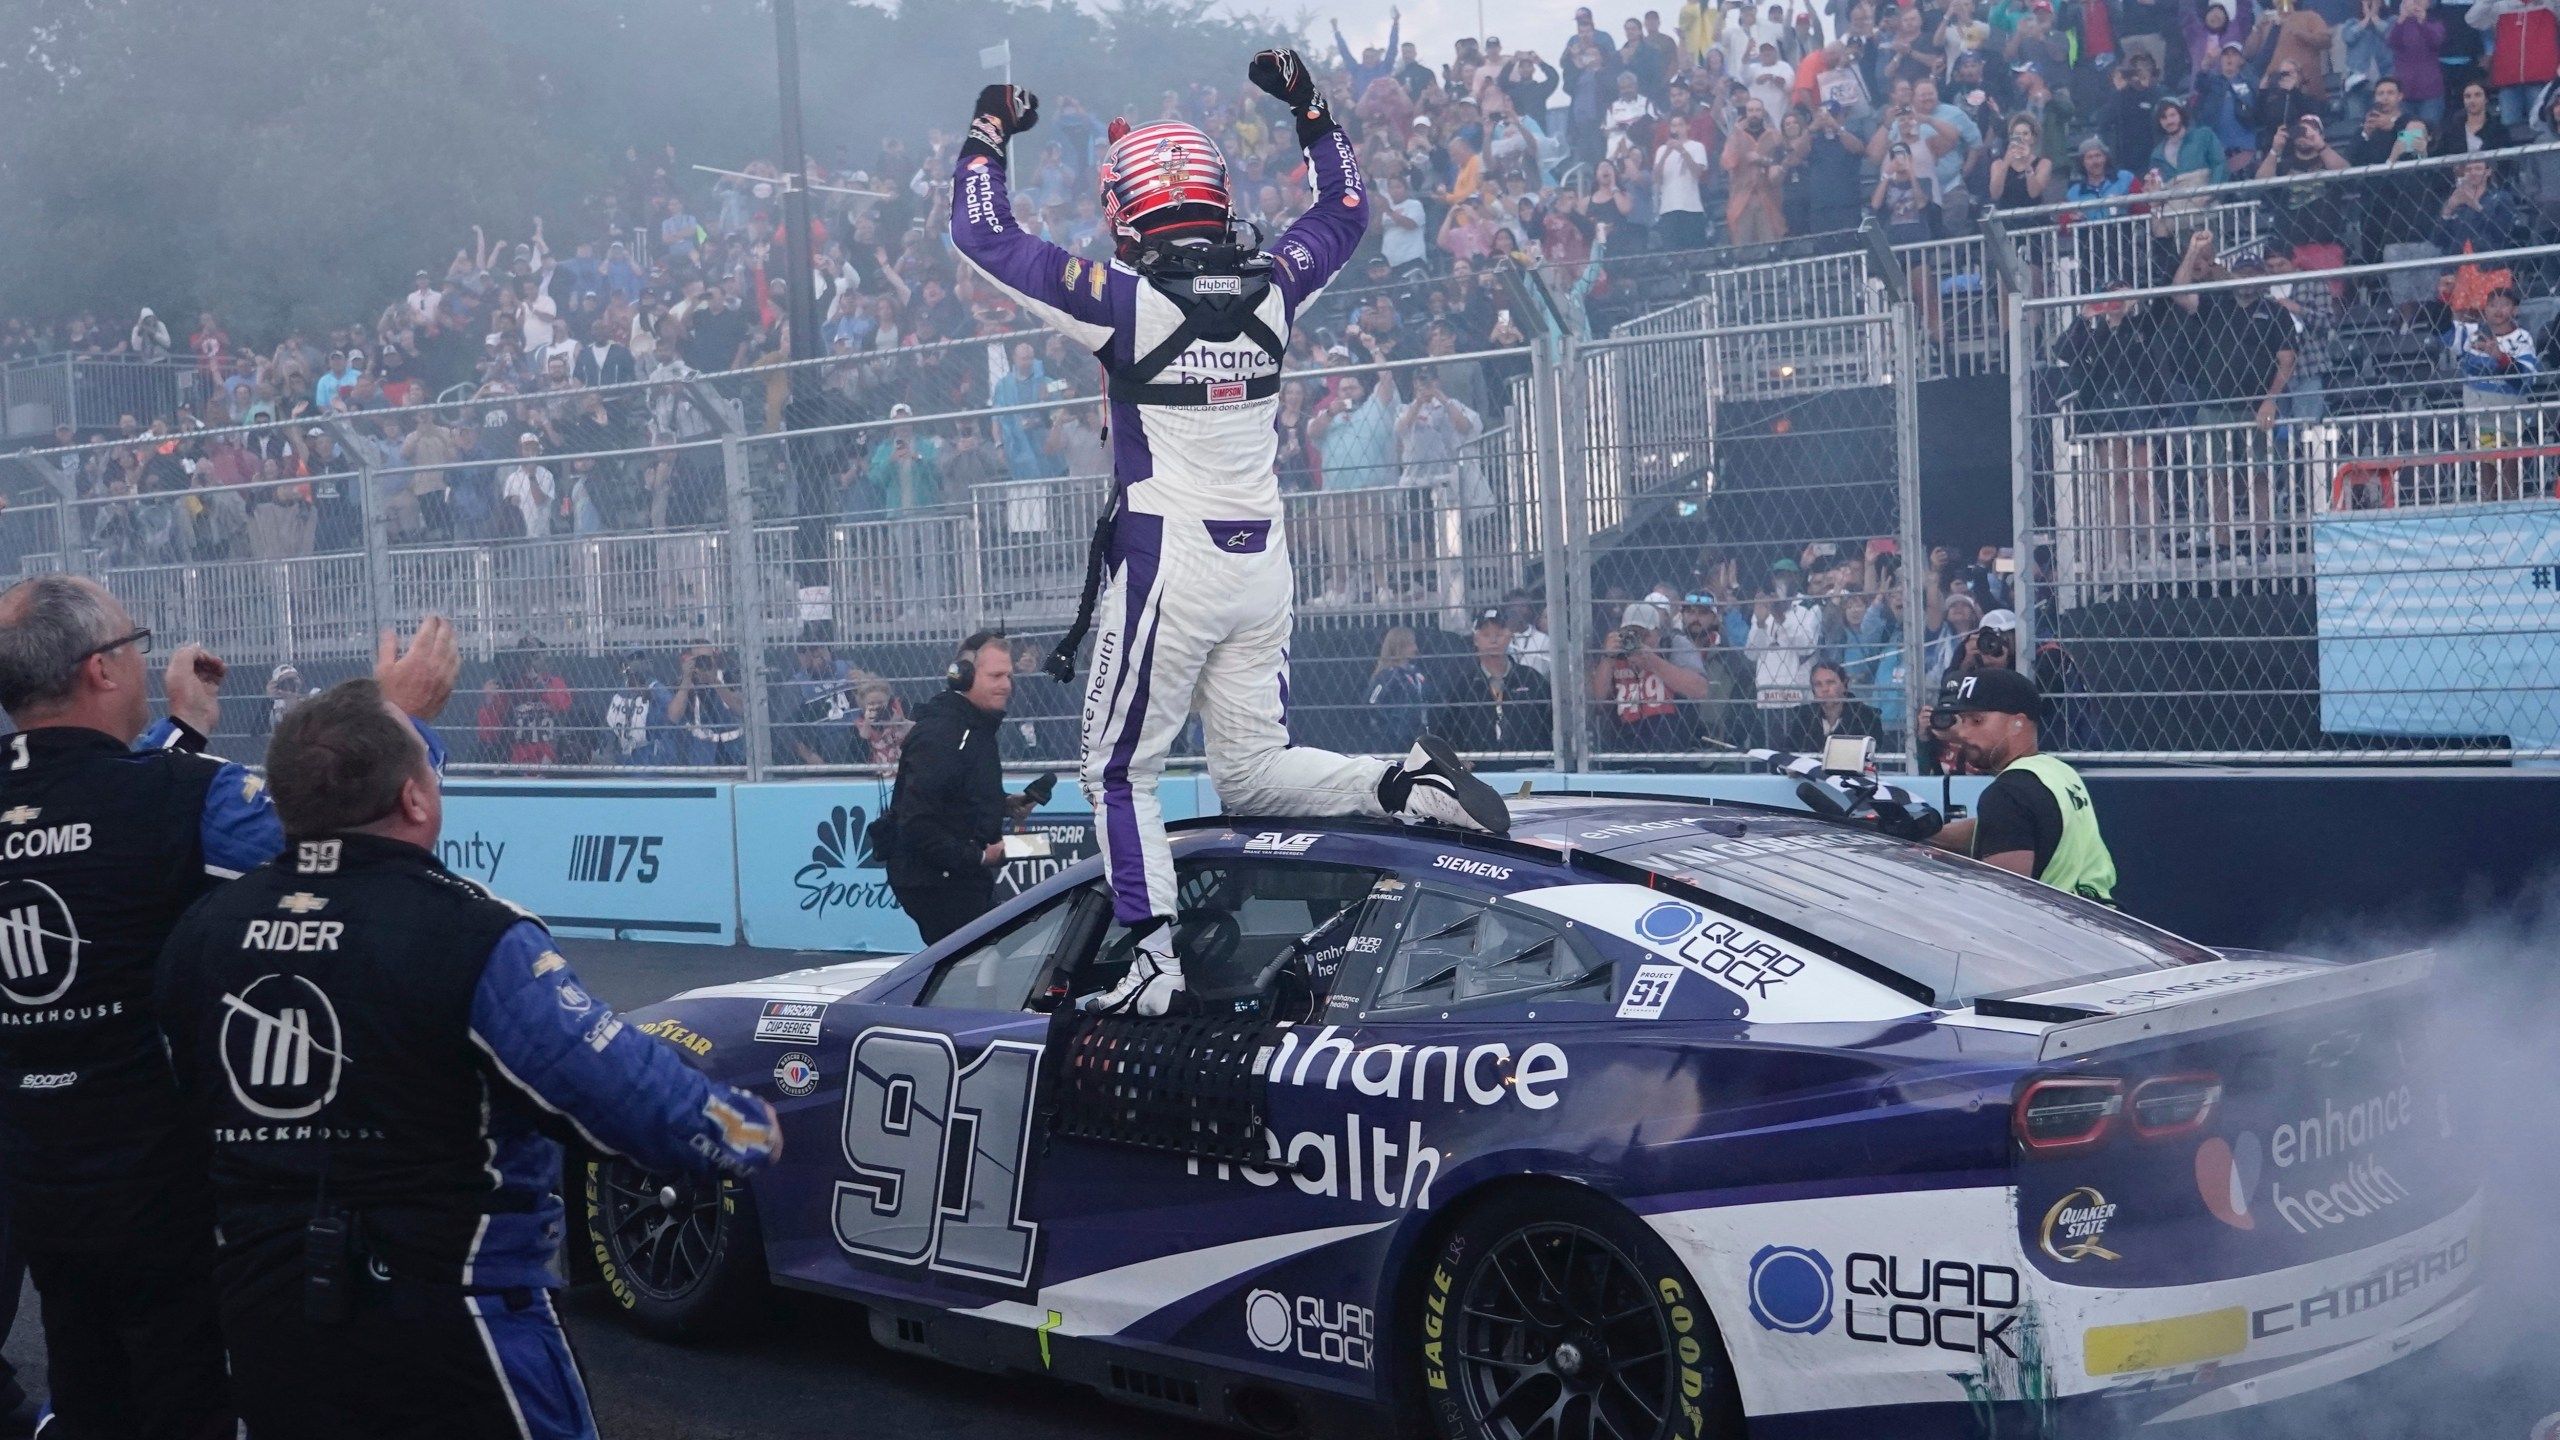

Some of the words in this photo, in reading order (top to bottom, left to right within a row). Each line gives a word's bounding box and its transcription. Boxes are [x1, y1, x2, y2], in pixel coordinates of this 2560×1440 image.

[966, 175, 982, 224] health
[980, 173, 1003, 234] enhance
[1198, 279, 1237, 292] Hybrid
[1212, 386, 1242, 398] SIMPSON
[1088, 631, 1117, 703] health
[297, 839, 344, 874] 99
[1245, 831, 1325, 851] SVG
[612, 836, 663, 884] 75
[1432, 854, 1514, 881] SIEMENS
[1366, 893, 1402, 902] CHEVROLET
[242, 920, 345, 952] RIDER
[1354, 944, 1379, 954] LOCK
[1357, 935, 1382, 946] QUAD
[1701, 921, 1806, 977] QUAD
[1679, 936, 1785, 1000] LOCK
[1329, 1000, 1350, 1009] health
[1332, 994, 1360, 1004] enhance
[1627, 979, 1669, 1006] 91
[0, 1001, 125, 1025] RACKHOUSE
[781, 1003, 817, 1017] NASCAR
[765, 1020, 784, 1032] CUP
[782, 1021, 812, 1035] SERIES
[2272, 1085, 2411, 1168] enhance
[832, 1026, 1040, 1289] 91
[2272, 1152, 2410, 1234] health
[2058, 1203, 2117, 1226] QUAKER
[2065, 1218, 2107, 1239] STATE
[1845, 1251, 2019, 1309] QUAD
[2252, 1238, 2469, 1340] CAMARO
[1296, 1295, 1375, 1341] QUAD
[1424, 1263, 1453, 1390] EAGLE
[1845, 1296, 2019, 1359] LOCK
[1297, 1326, 1376, 1373] LOCK
